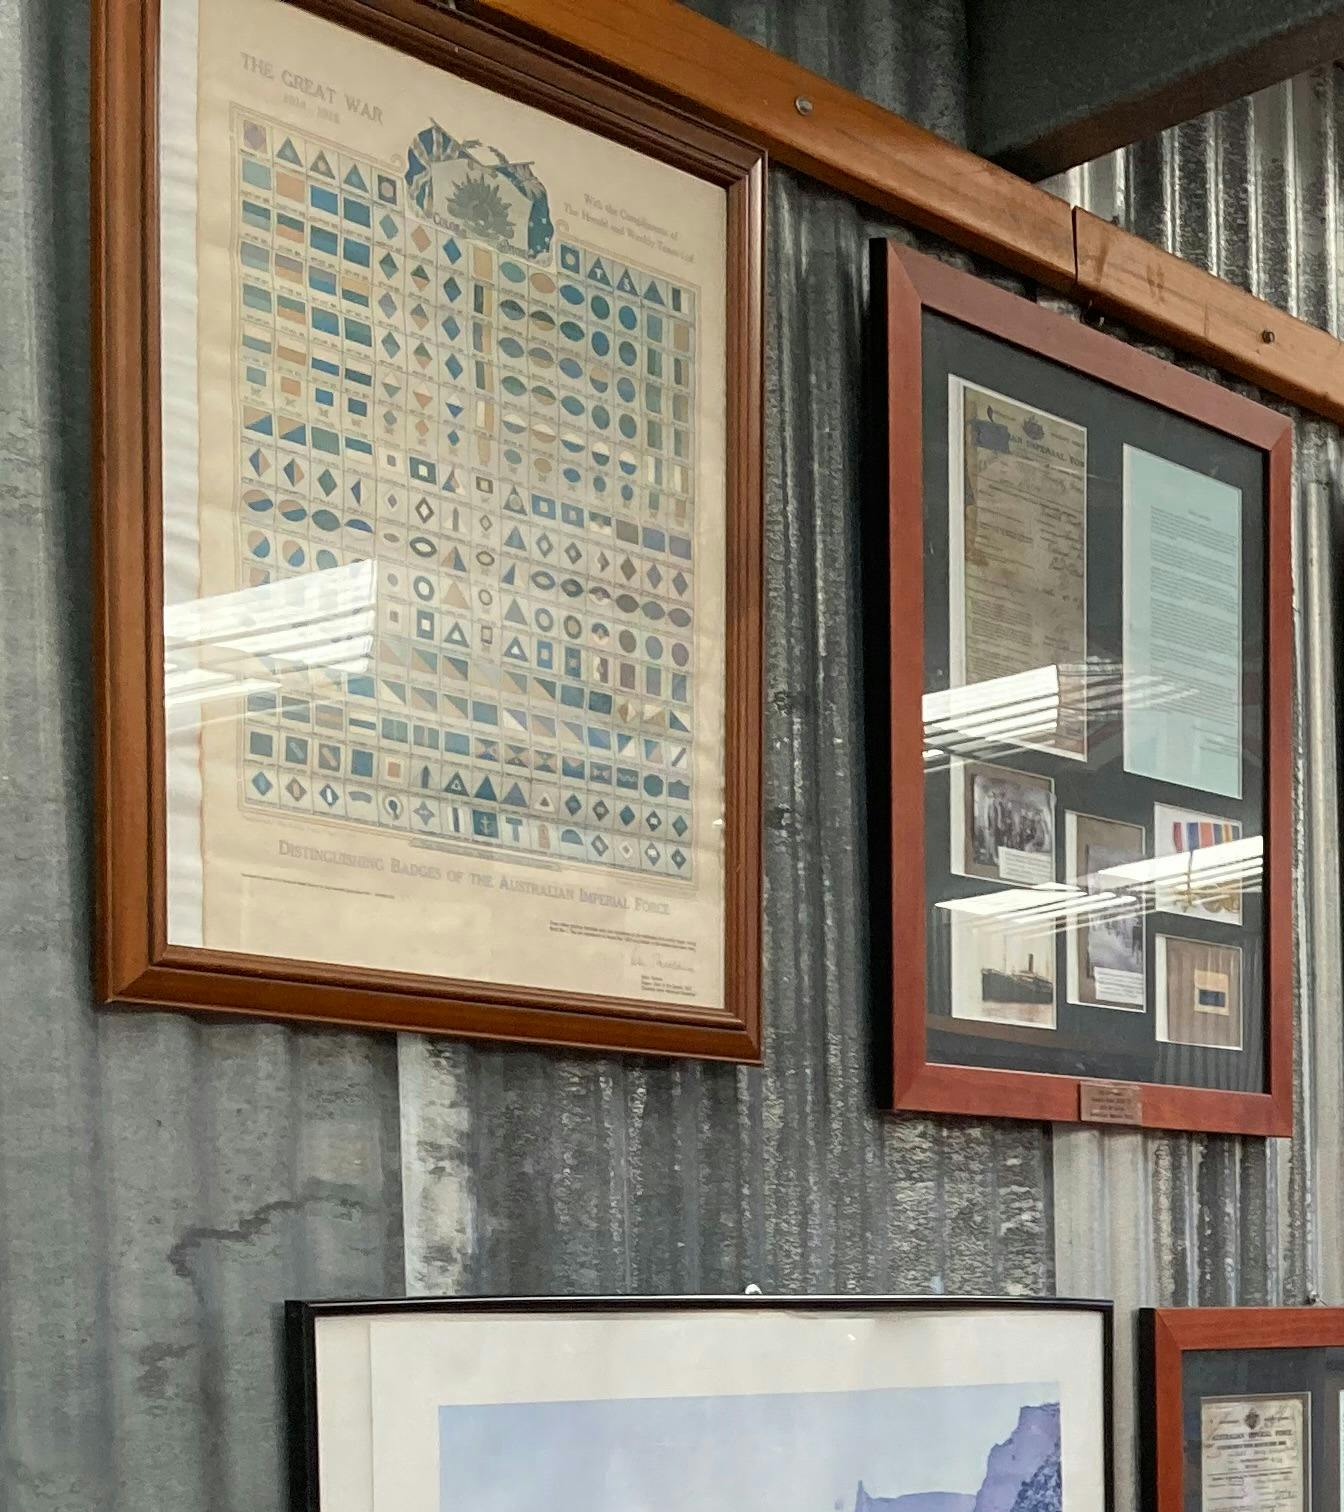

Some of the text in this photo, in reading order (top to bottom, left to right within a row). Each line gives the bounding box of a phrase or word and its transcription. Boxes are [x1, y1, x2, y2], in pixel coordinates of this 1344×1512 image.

[240, 52, 383, 126] THE GREAT WAR
[390, 857, 442, 880] BADGES
[499, 875, 575, 901] AUSTRALIAN
[579, 887, 630, 910] IMPERIAL
